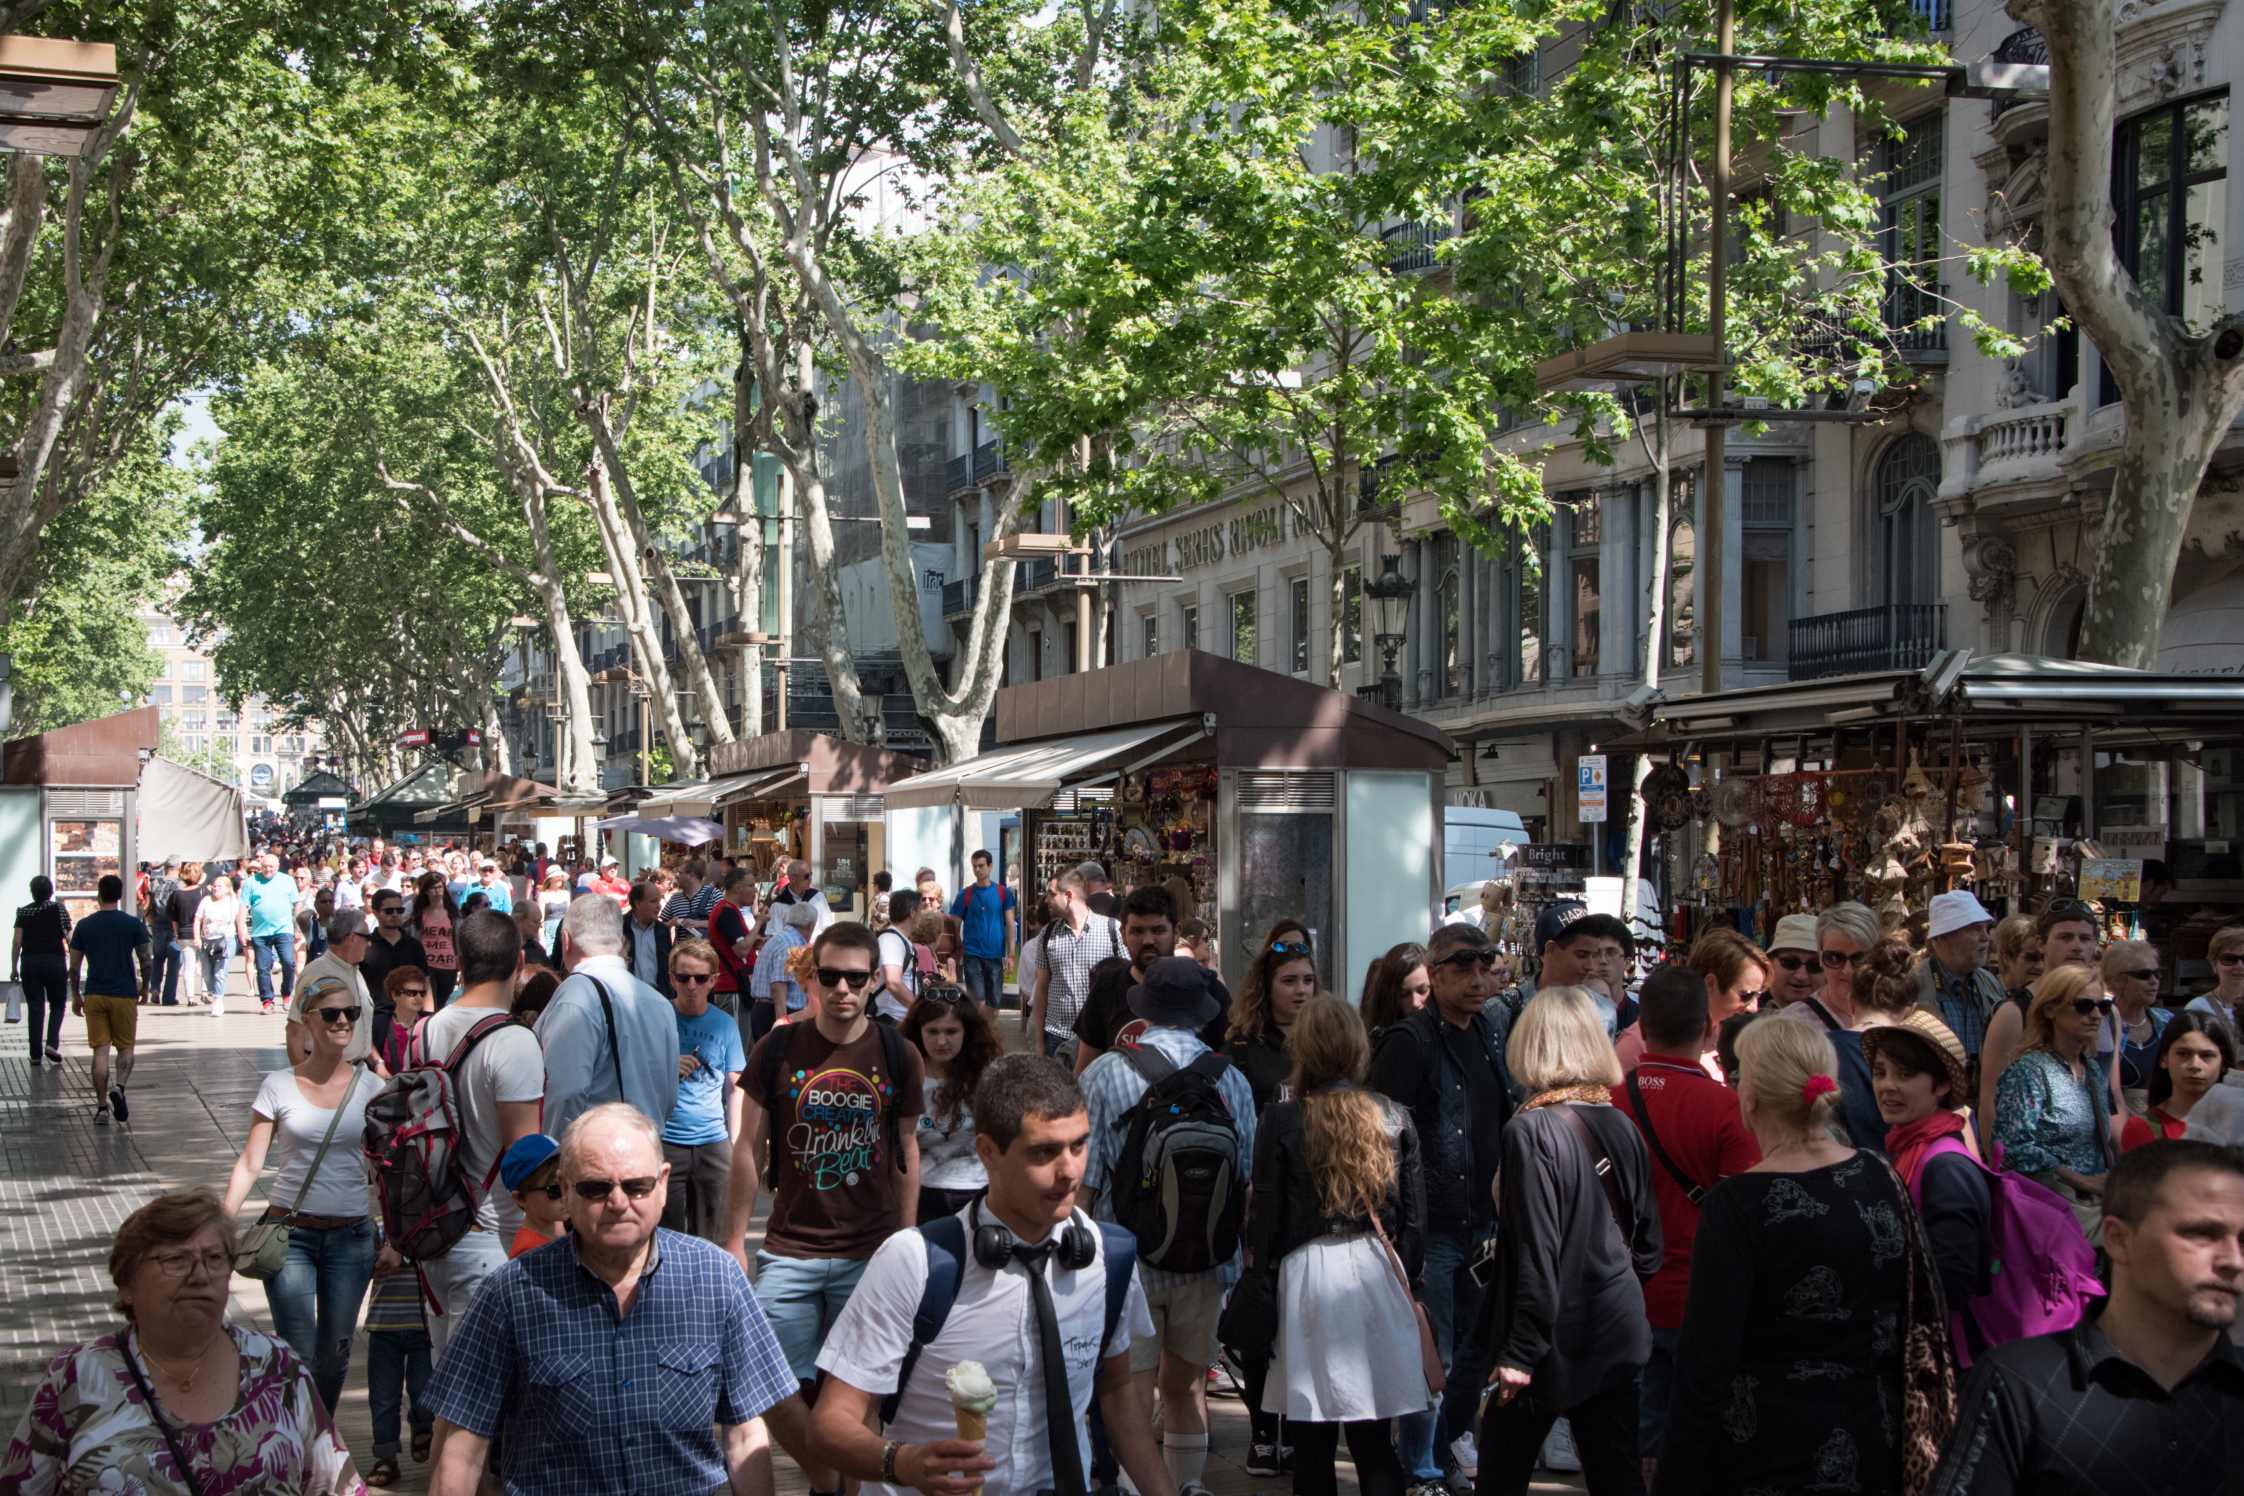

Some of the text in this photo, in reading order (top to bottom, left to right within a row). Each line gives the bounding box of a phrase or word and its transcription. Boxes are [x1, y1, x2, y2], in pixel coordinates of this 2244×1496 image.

[1175, 522, 1225, 570] SERHS
[1230, 504, 1286, 555] RIVOLI
[1582, 767, 1590, 784] P
[1529, 848, 1566, 864] Bright
[425, 954, 454, 963] OAR
[829, 1079, 857, 1090] THE
[1638, 1076, 1665, 1087] BOSS
[808, 1090, 873, 1110] BOOGIE
[786, 1117, 881, 1164] Franklin
[807, 1145, 873, 1190] Beat
